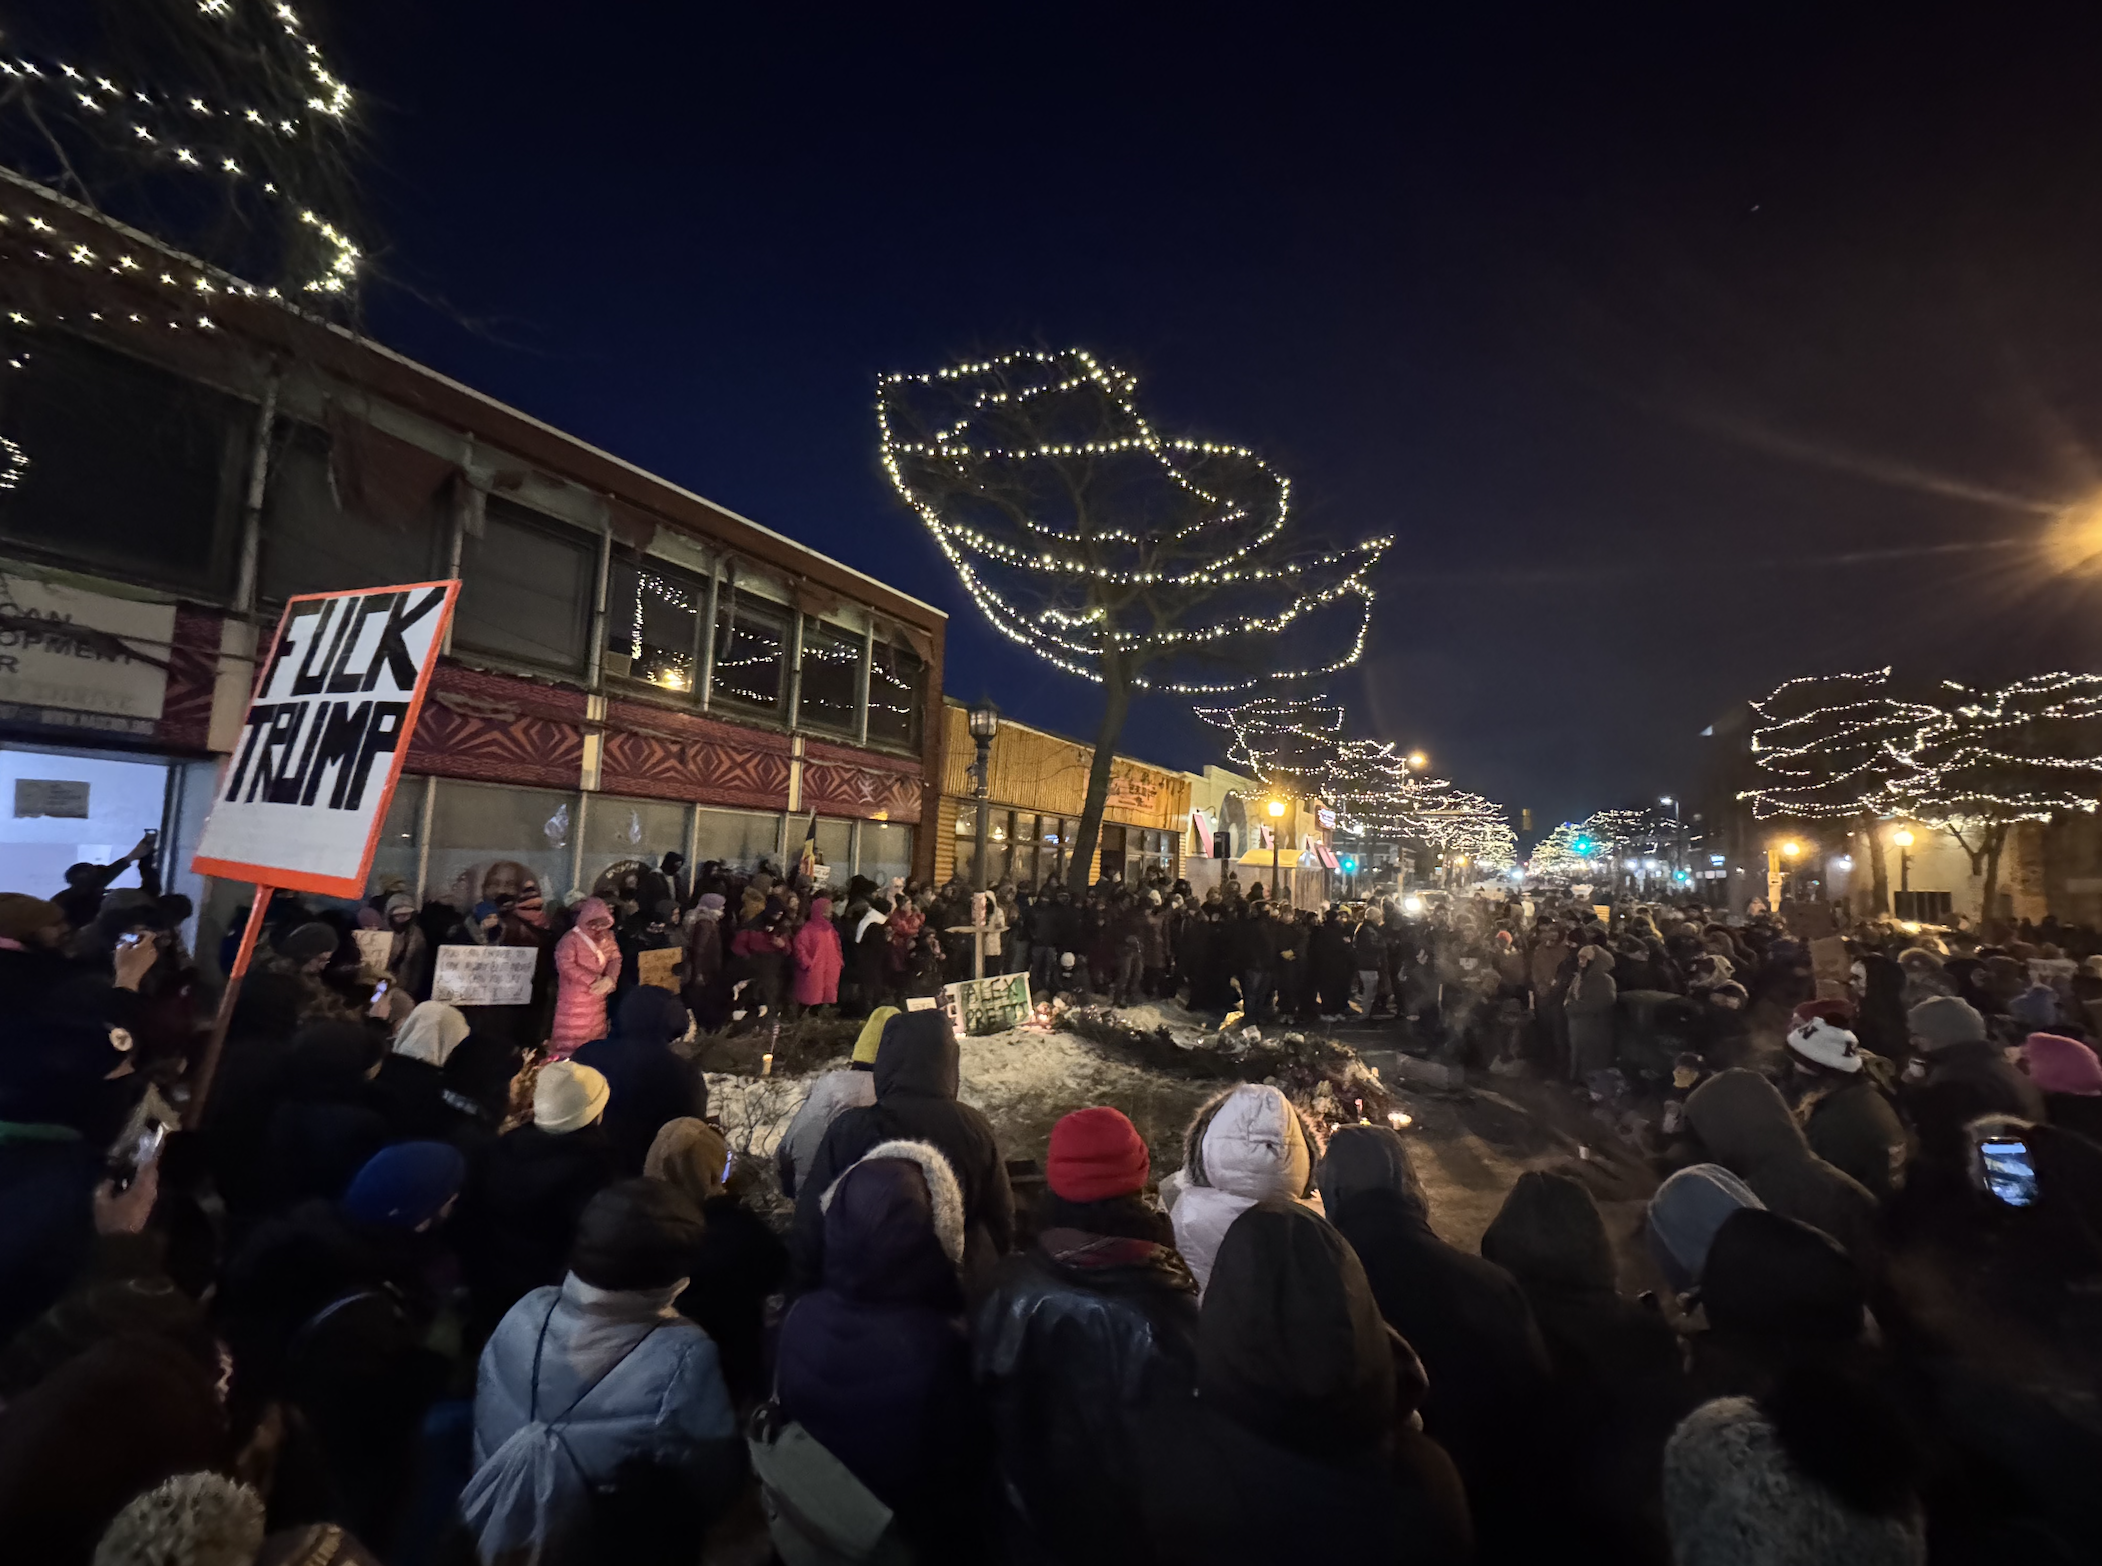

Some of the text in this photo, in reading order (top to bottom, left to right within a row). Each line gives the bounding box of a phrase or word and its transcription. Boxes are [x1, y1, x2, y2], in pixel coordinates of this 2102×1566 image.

[257, 586, 448, 699] FUCK
[225, 701, 411, 811] TRUMP
[963, 978, 1019, 1003] ALEX
